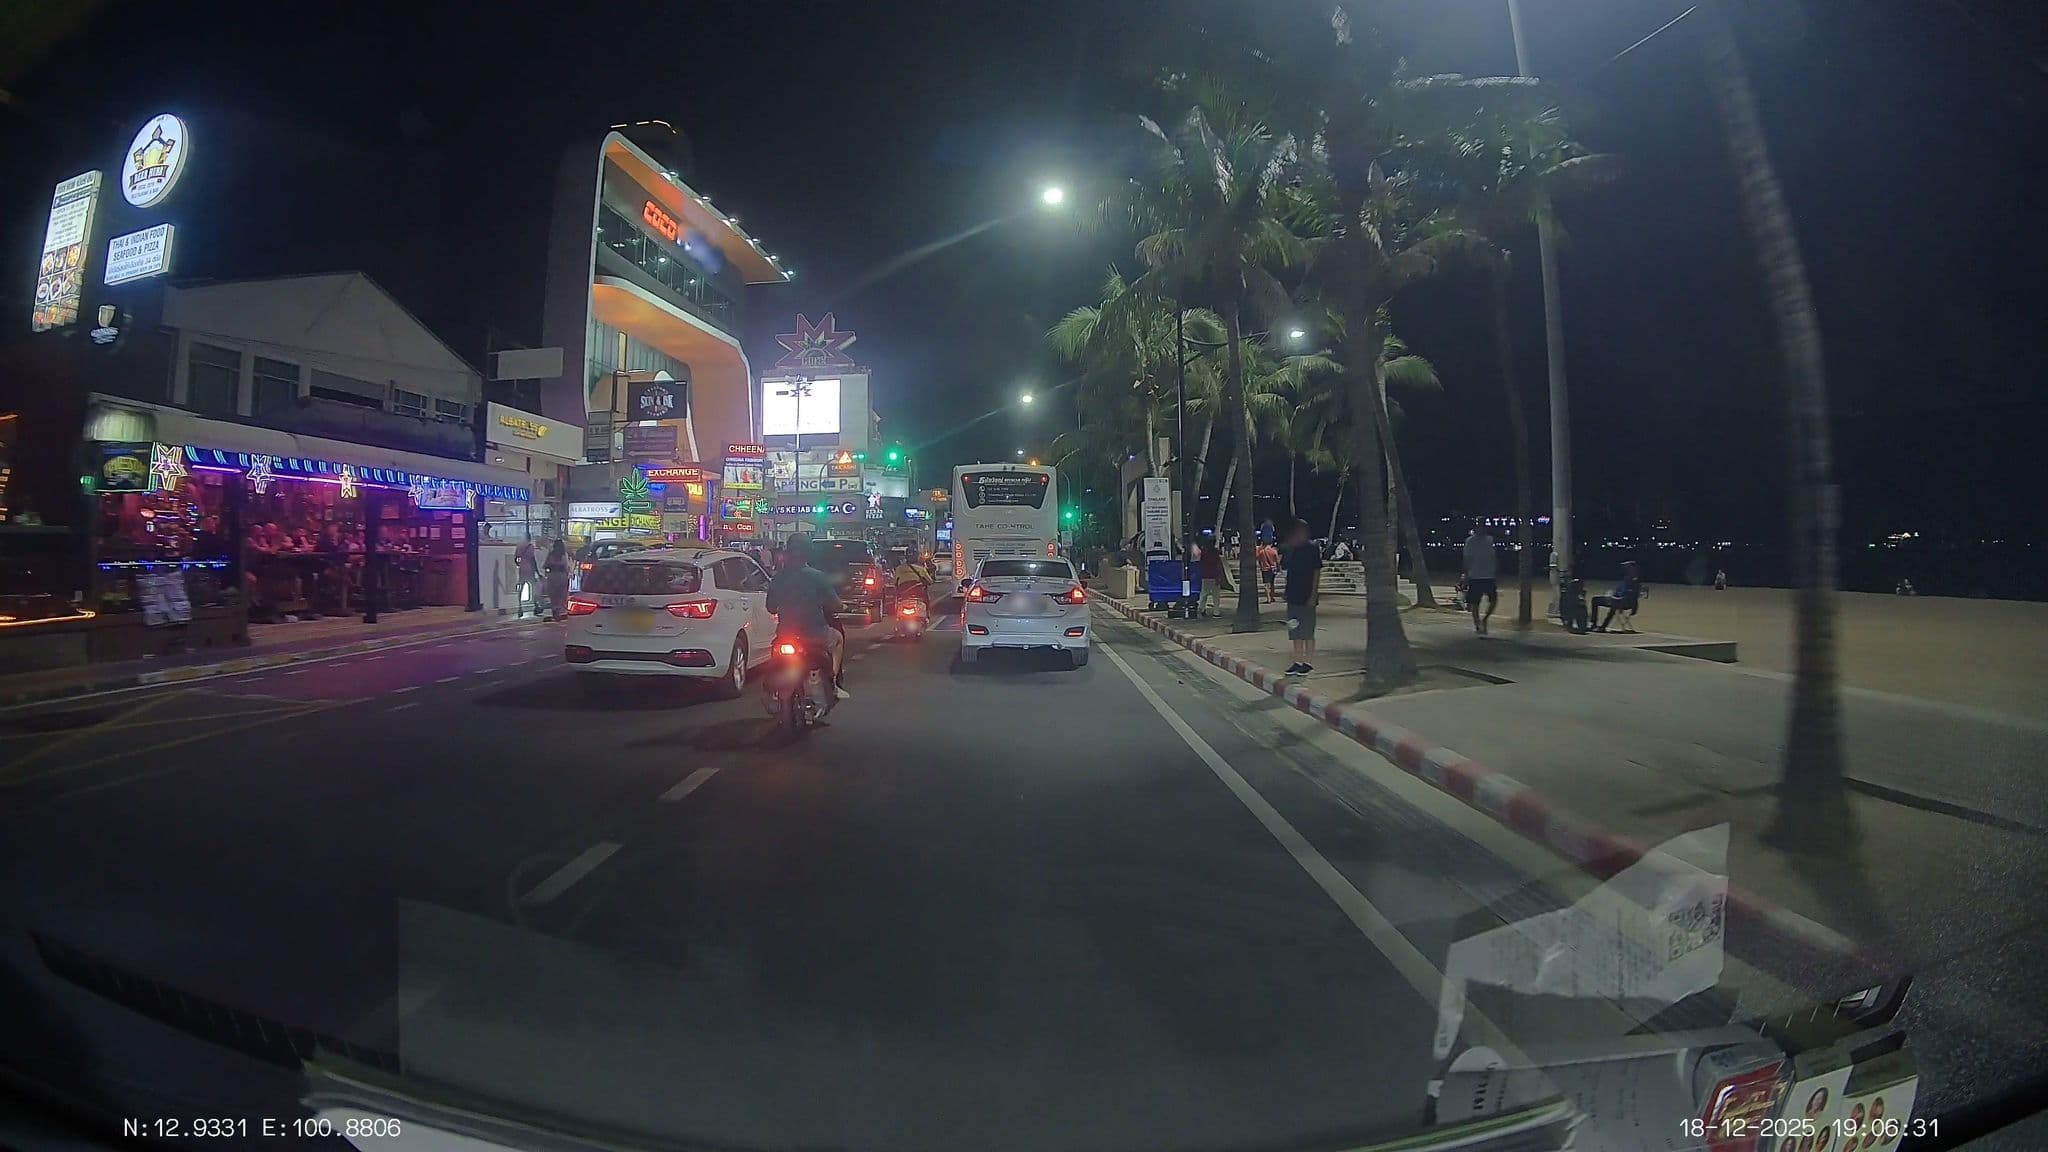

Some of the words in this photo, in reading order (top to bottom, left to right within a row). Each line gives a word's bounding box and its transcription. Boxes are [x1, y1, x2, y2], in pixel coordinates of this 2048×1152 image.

[113, 238, 124, 250] THAI
[130, 231, 149, 245] INDIAN
[149, 227, 165, 239] FOOD
[113, 246, 137, 261] SEAFOOD
[144, 240, 159, 253] PIZZA
[648, 468, 699, 477] EXCHANGE
